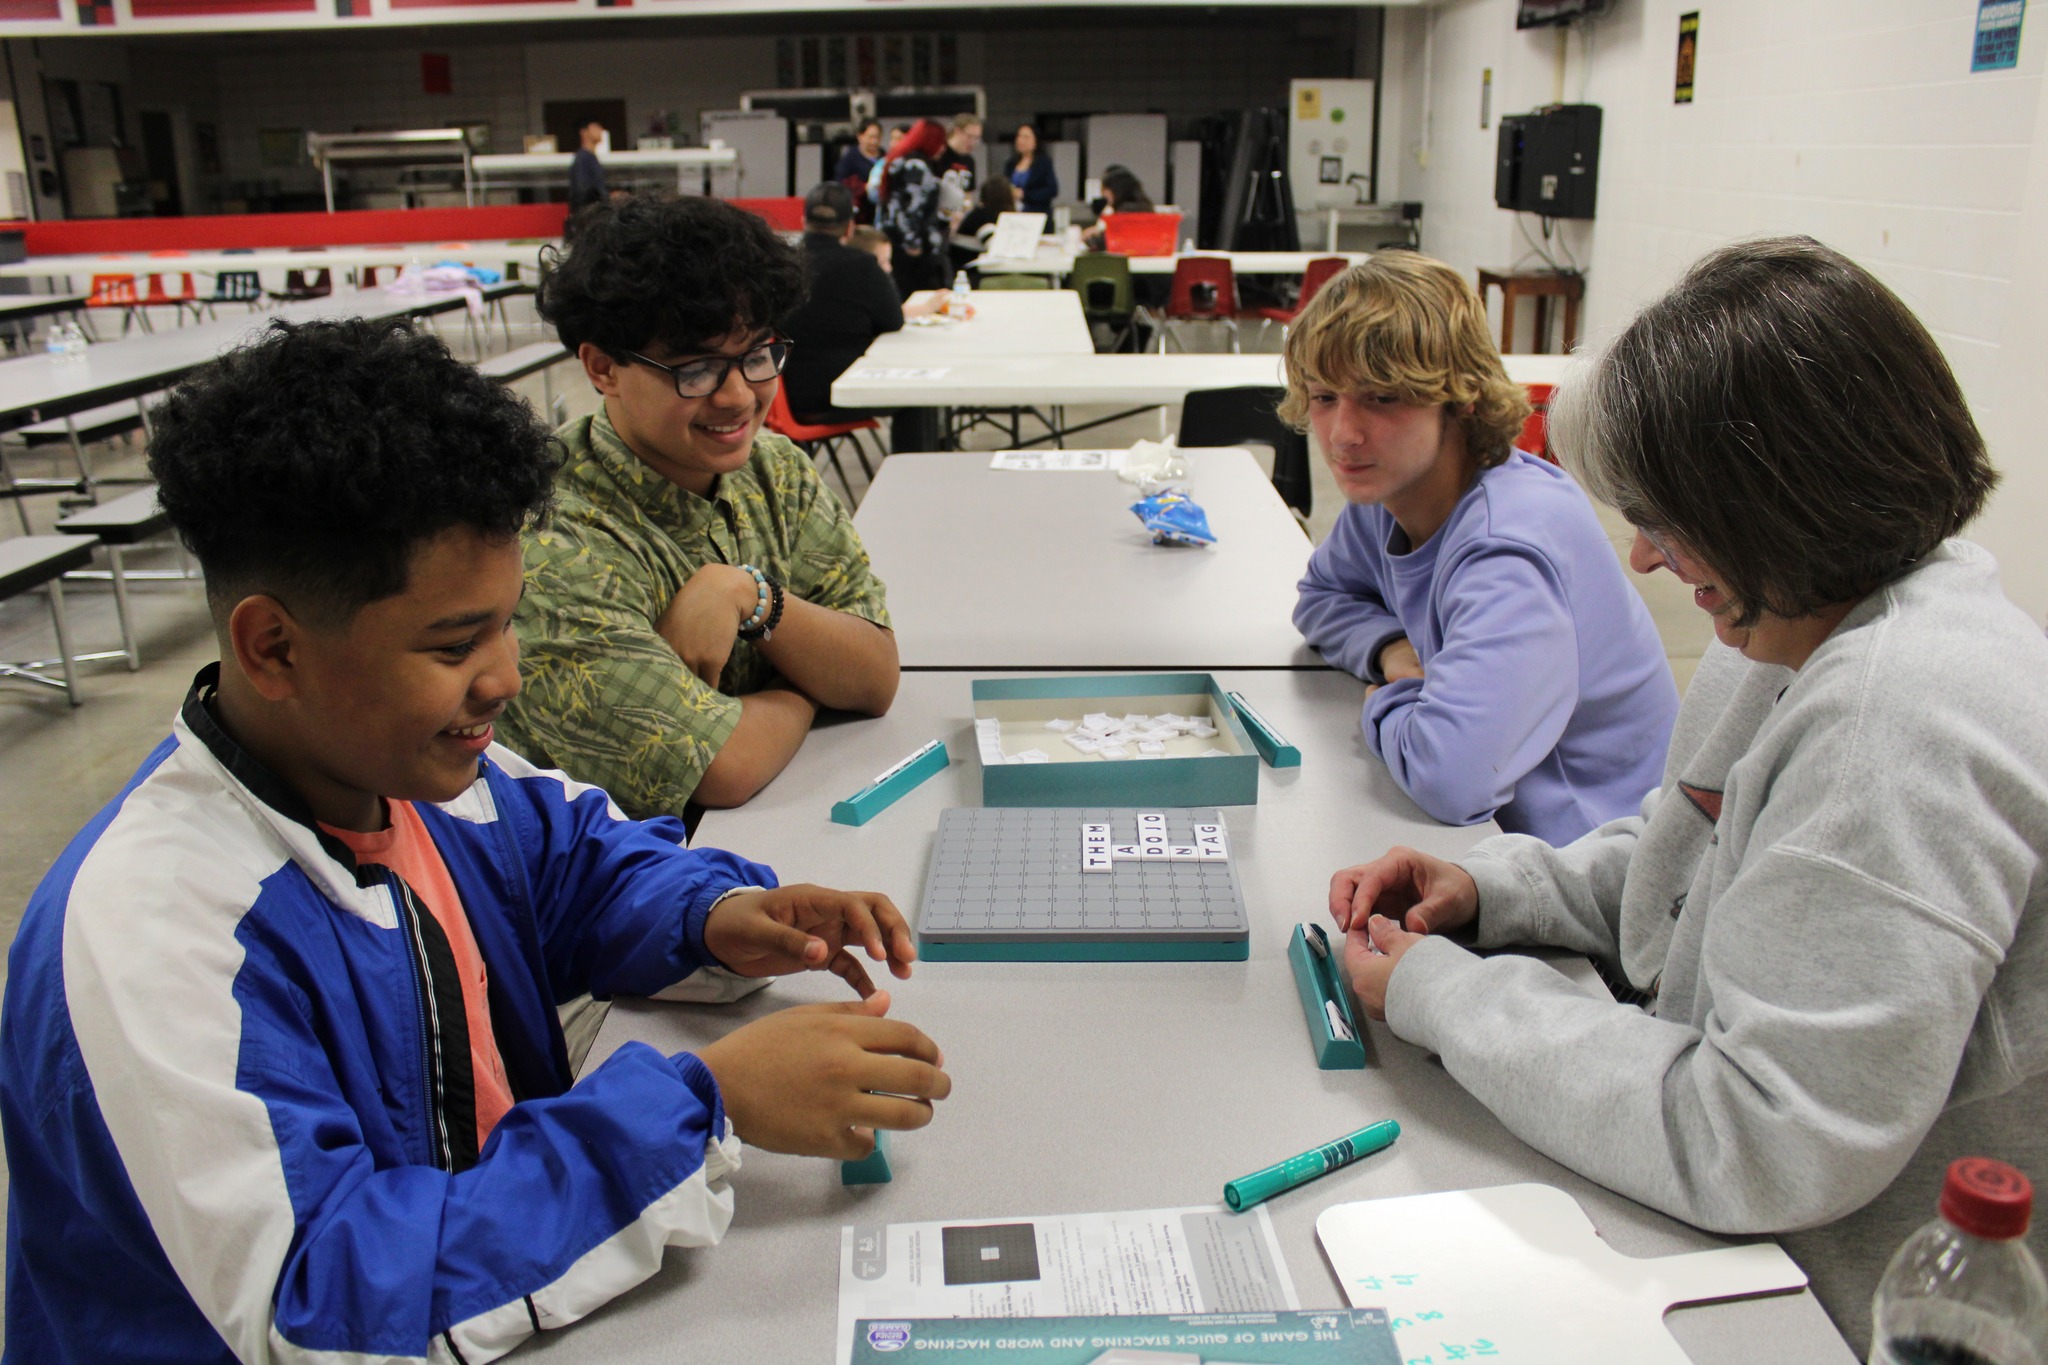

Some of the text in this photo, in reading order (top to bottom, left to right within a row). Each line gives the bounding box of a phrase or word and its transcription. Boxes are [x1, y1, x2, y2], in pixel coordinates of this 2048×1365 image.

[1088, 825, 1106, 866] THEM
[1144, 815, 1163, 855] DOJO
[1201, 826, 1222, 856] TAG
[914, 1331, 1341, 1350] THE GAME OF QUICK STACKING AND WORD HACKING
